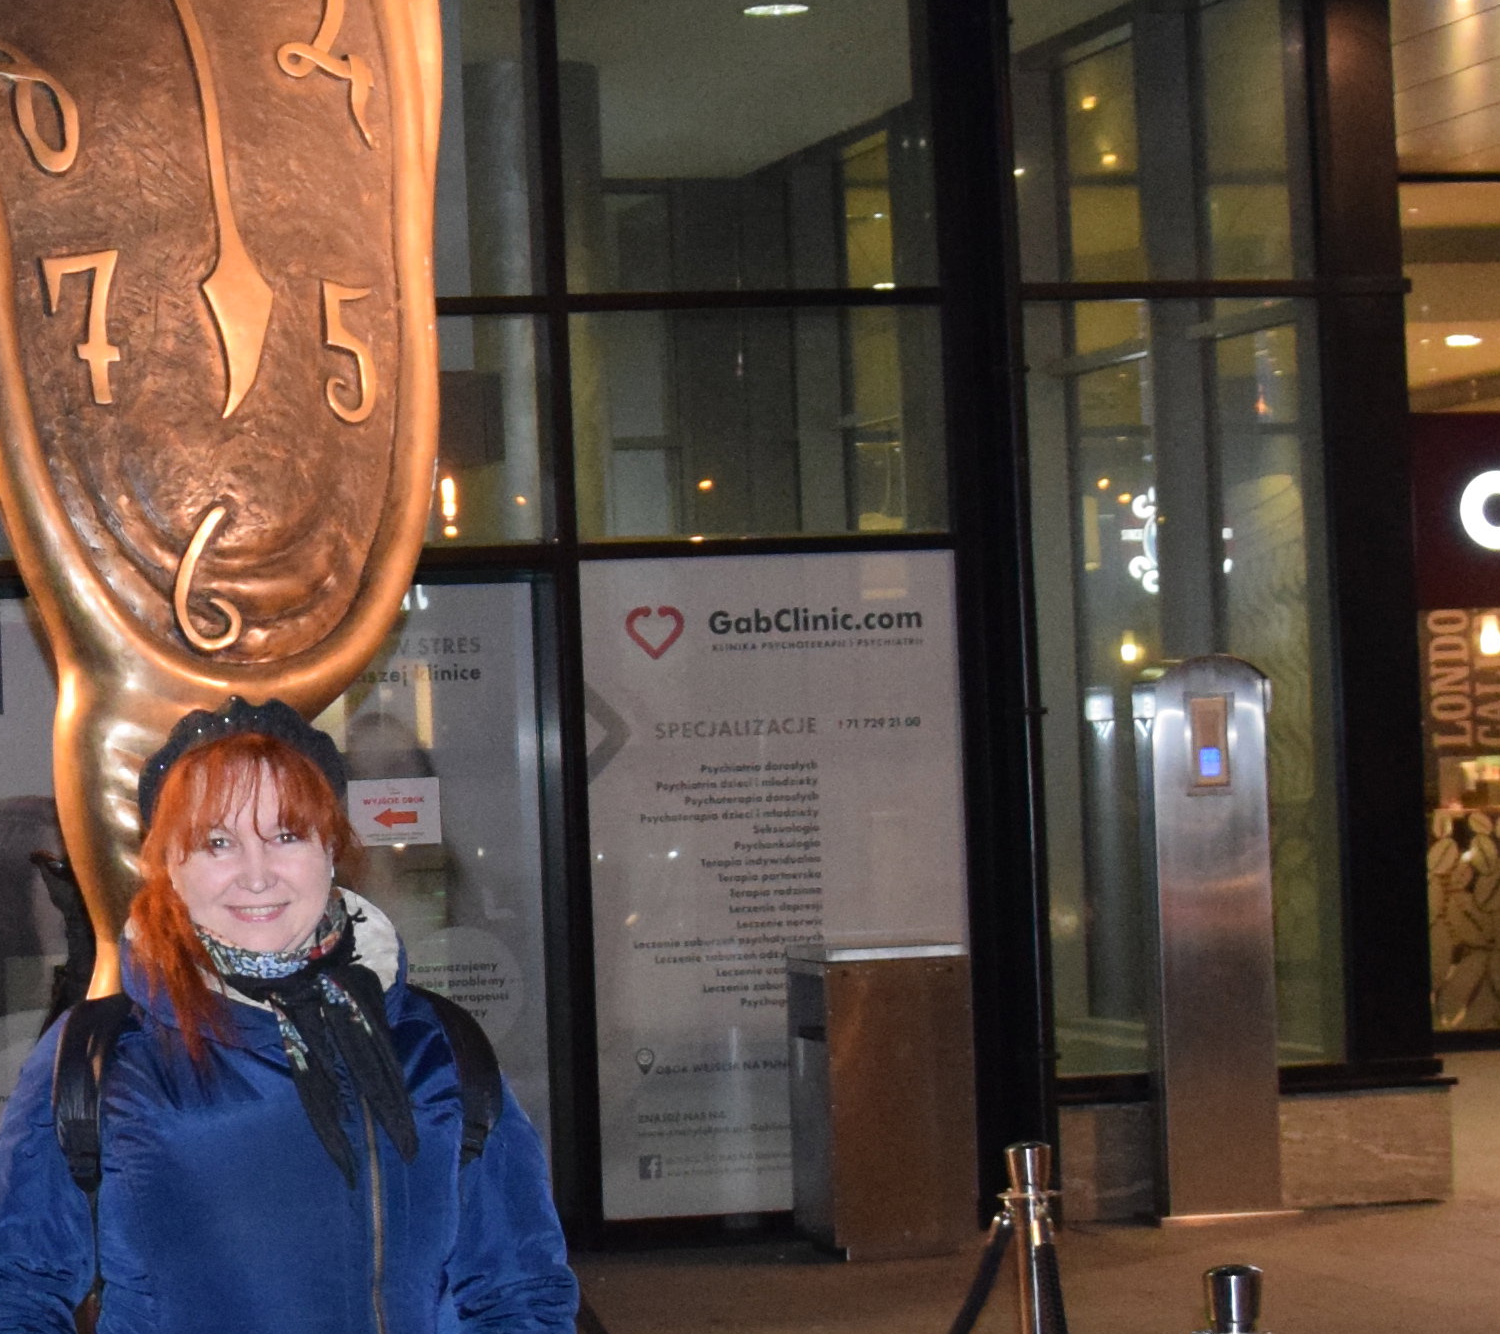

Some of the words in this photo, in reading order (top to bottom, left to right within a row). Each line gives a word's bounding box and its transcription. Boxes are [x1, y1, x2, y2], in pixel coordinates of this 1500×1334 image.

[40, 249, 121, 406] 7
[318, 277, 378, 424] 5
[173, 503, 243, 653] 6
[417, 637, 481, 656] STRES
[707, 607, 923, 636] GabClinic.com
[654, 717, 818, 742] SPECJALIZACJE
[1426, 608, 1473, 749] LONDO
